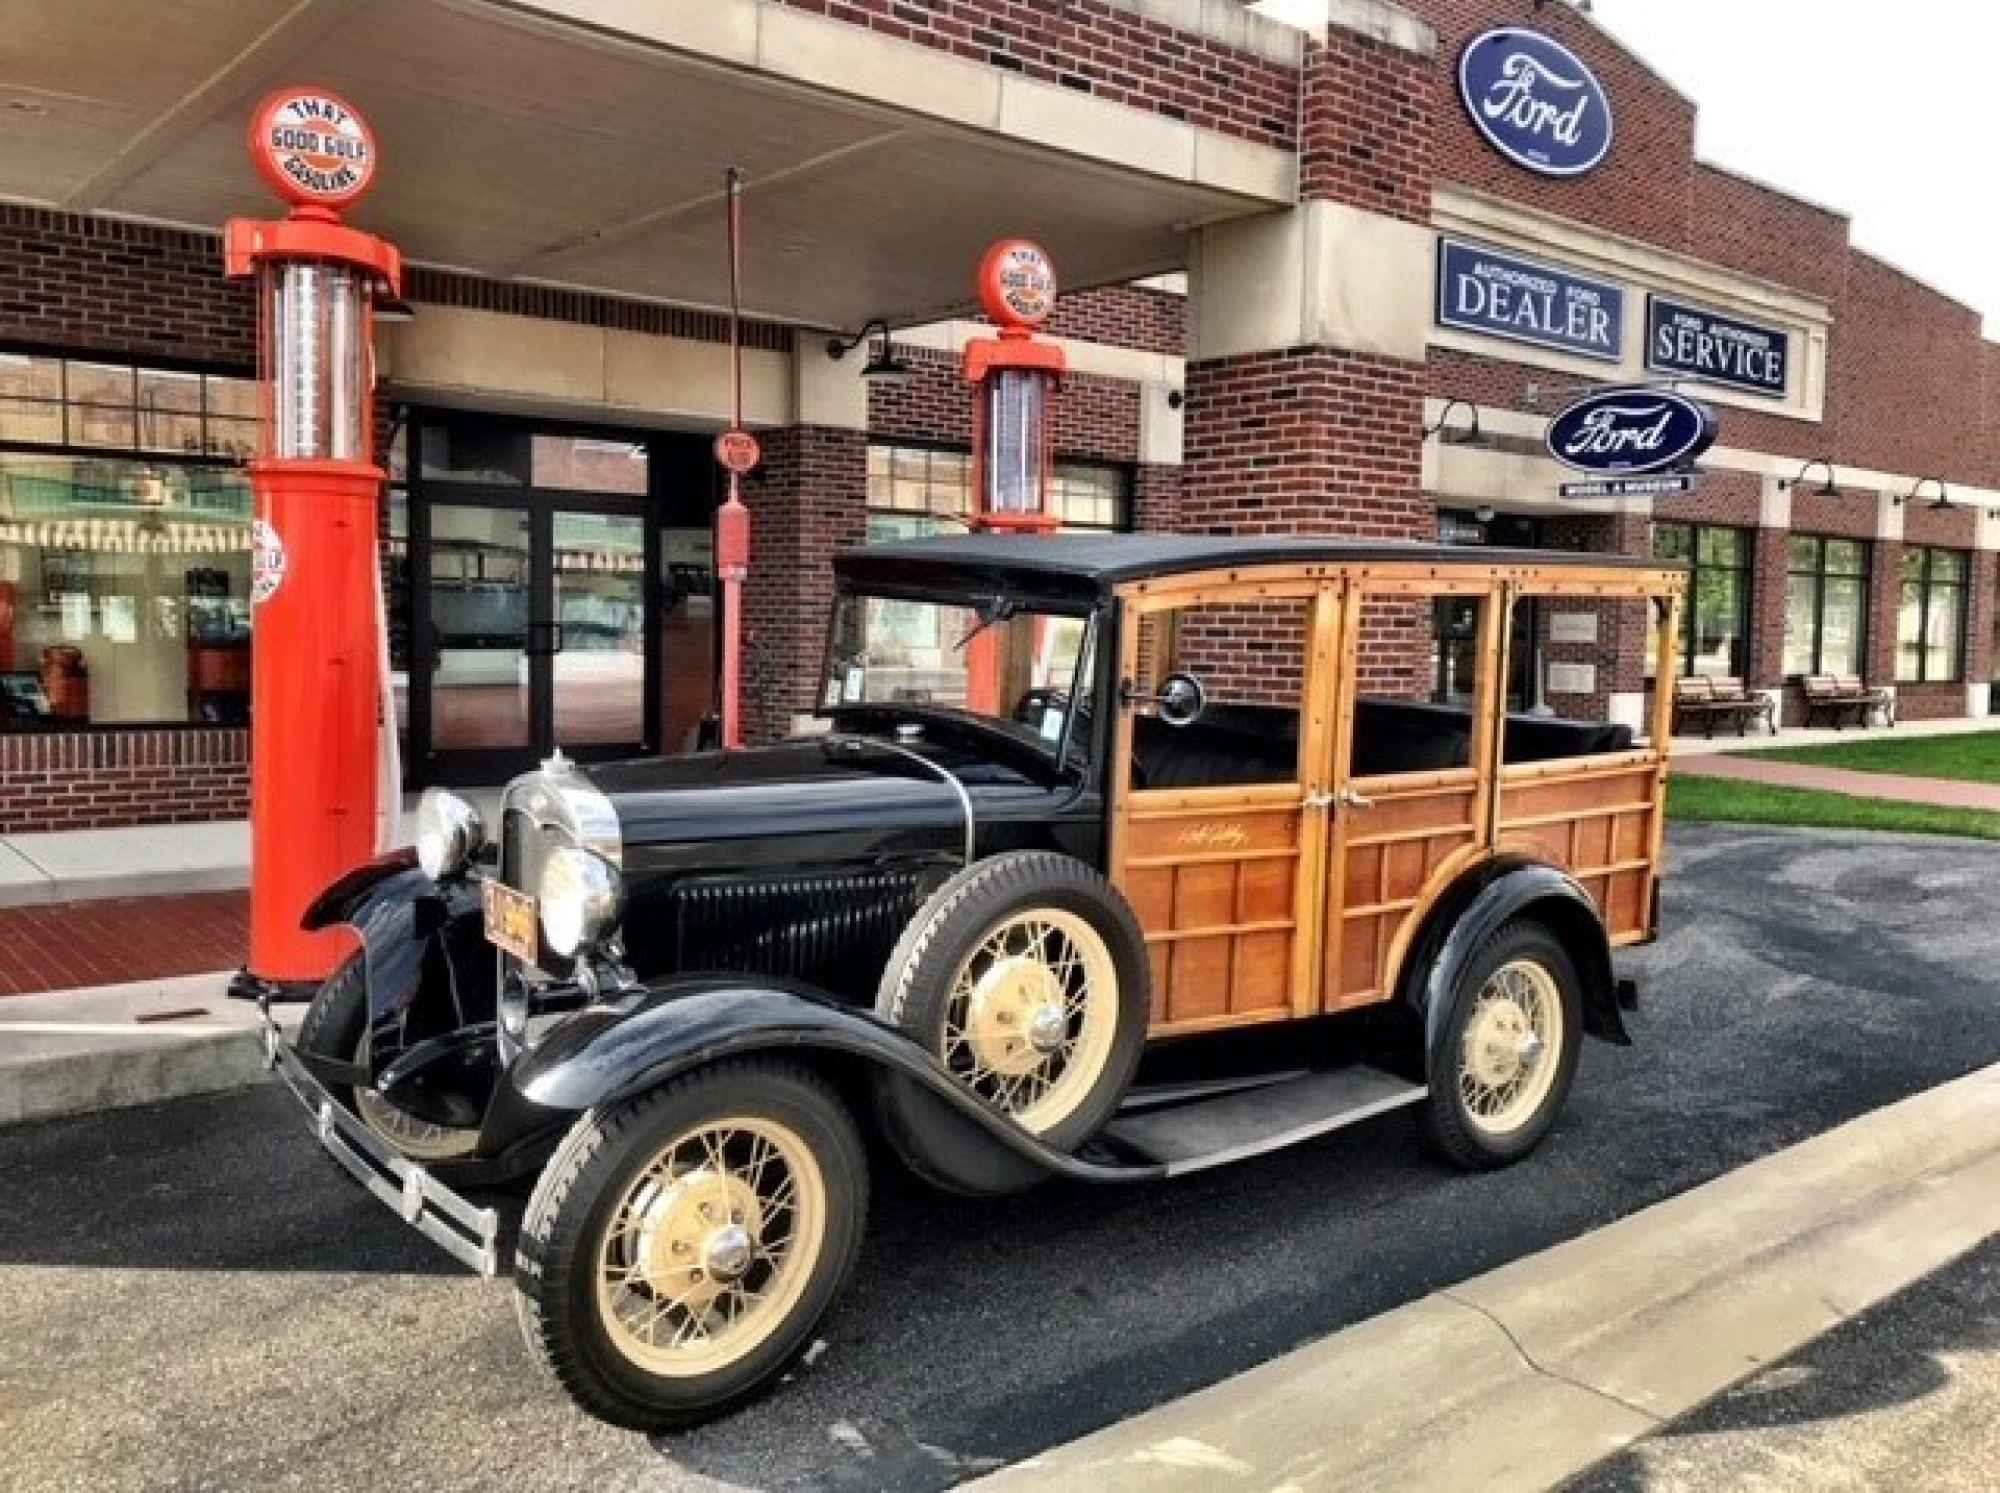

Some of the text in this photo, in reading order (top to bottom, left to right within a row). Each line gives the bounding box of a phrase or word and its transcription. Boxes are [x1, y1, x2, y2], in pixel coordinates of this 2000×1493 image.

[287, 99, 347, 124] THAT
[1483, 52, 1588, 146] Ford
[271, 126, 364, 159] GOOD GULF
[283, 154, 357, 190] GASOLINE
[1472, 260, 1601, 307] AUTHORIZED FORD
[1456, 272, 1611, 347] DEALER
[1657, 322, 1782, 385] SERVICE
[1564, 402, 1673, 453] Ford
